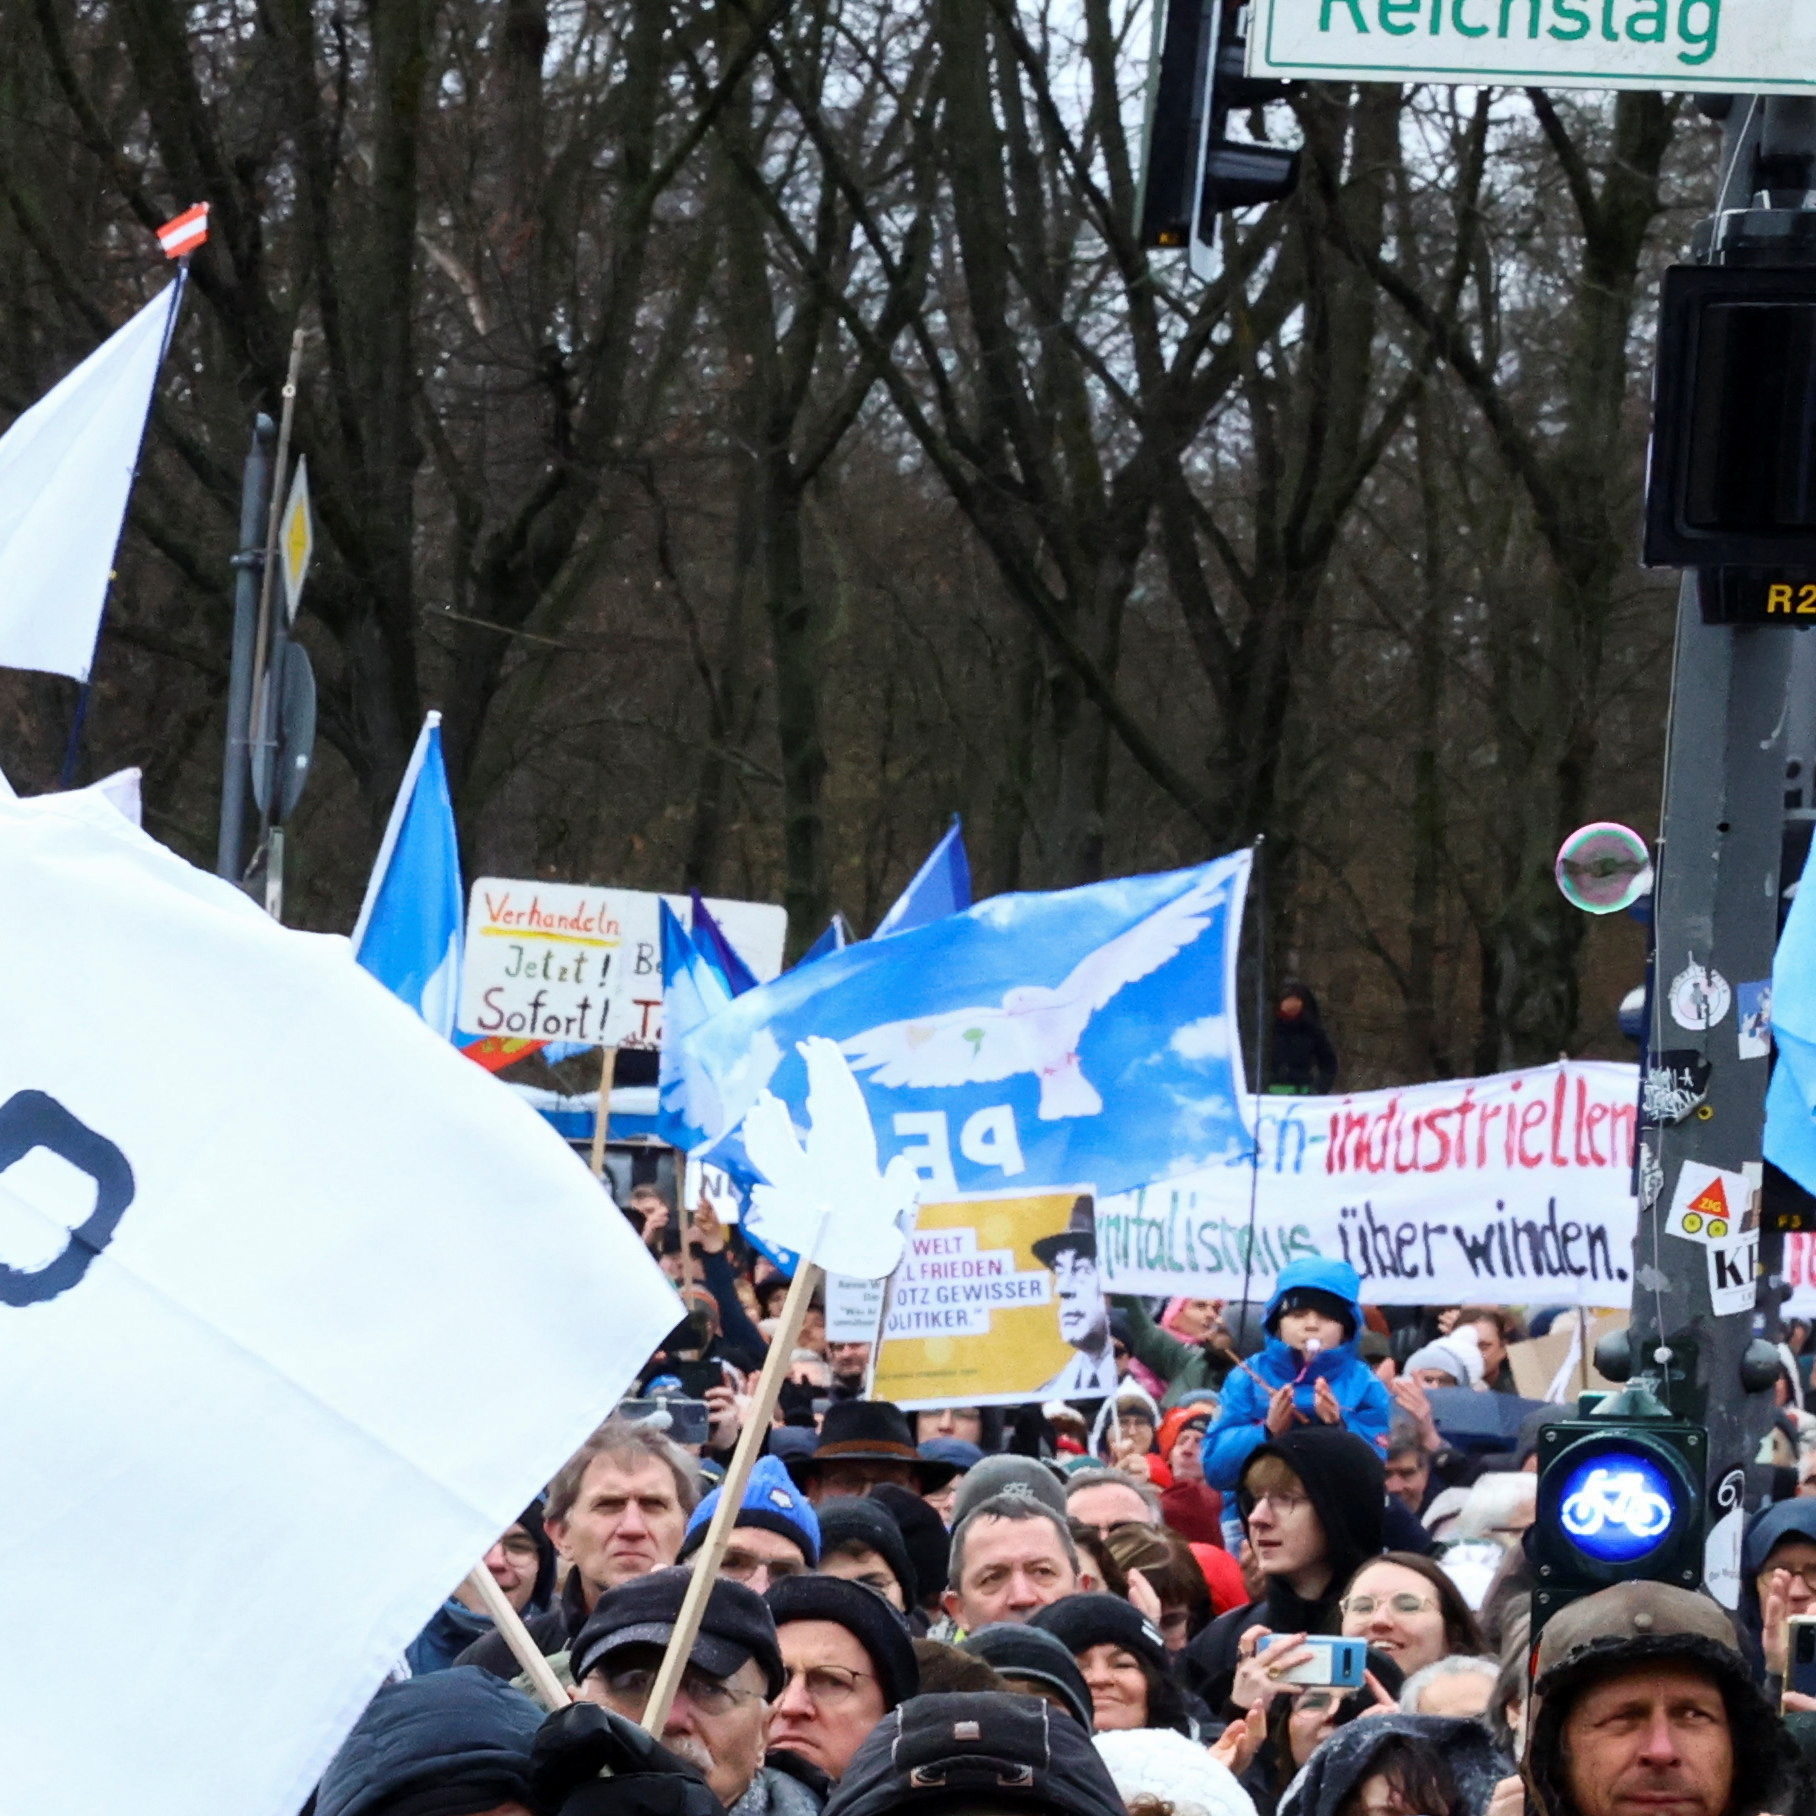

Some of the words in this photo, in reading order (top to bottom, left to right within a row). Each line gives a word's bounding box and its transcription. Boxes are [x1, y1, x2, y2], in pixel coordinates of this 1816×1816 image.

[484, 891, 620, 936] Verhandeln
[477, 987, 611, 1041] Sofort!
[912, 1237, 963, 1256] WELT
[936, 1280, 1043, 1304] GEWISSER
